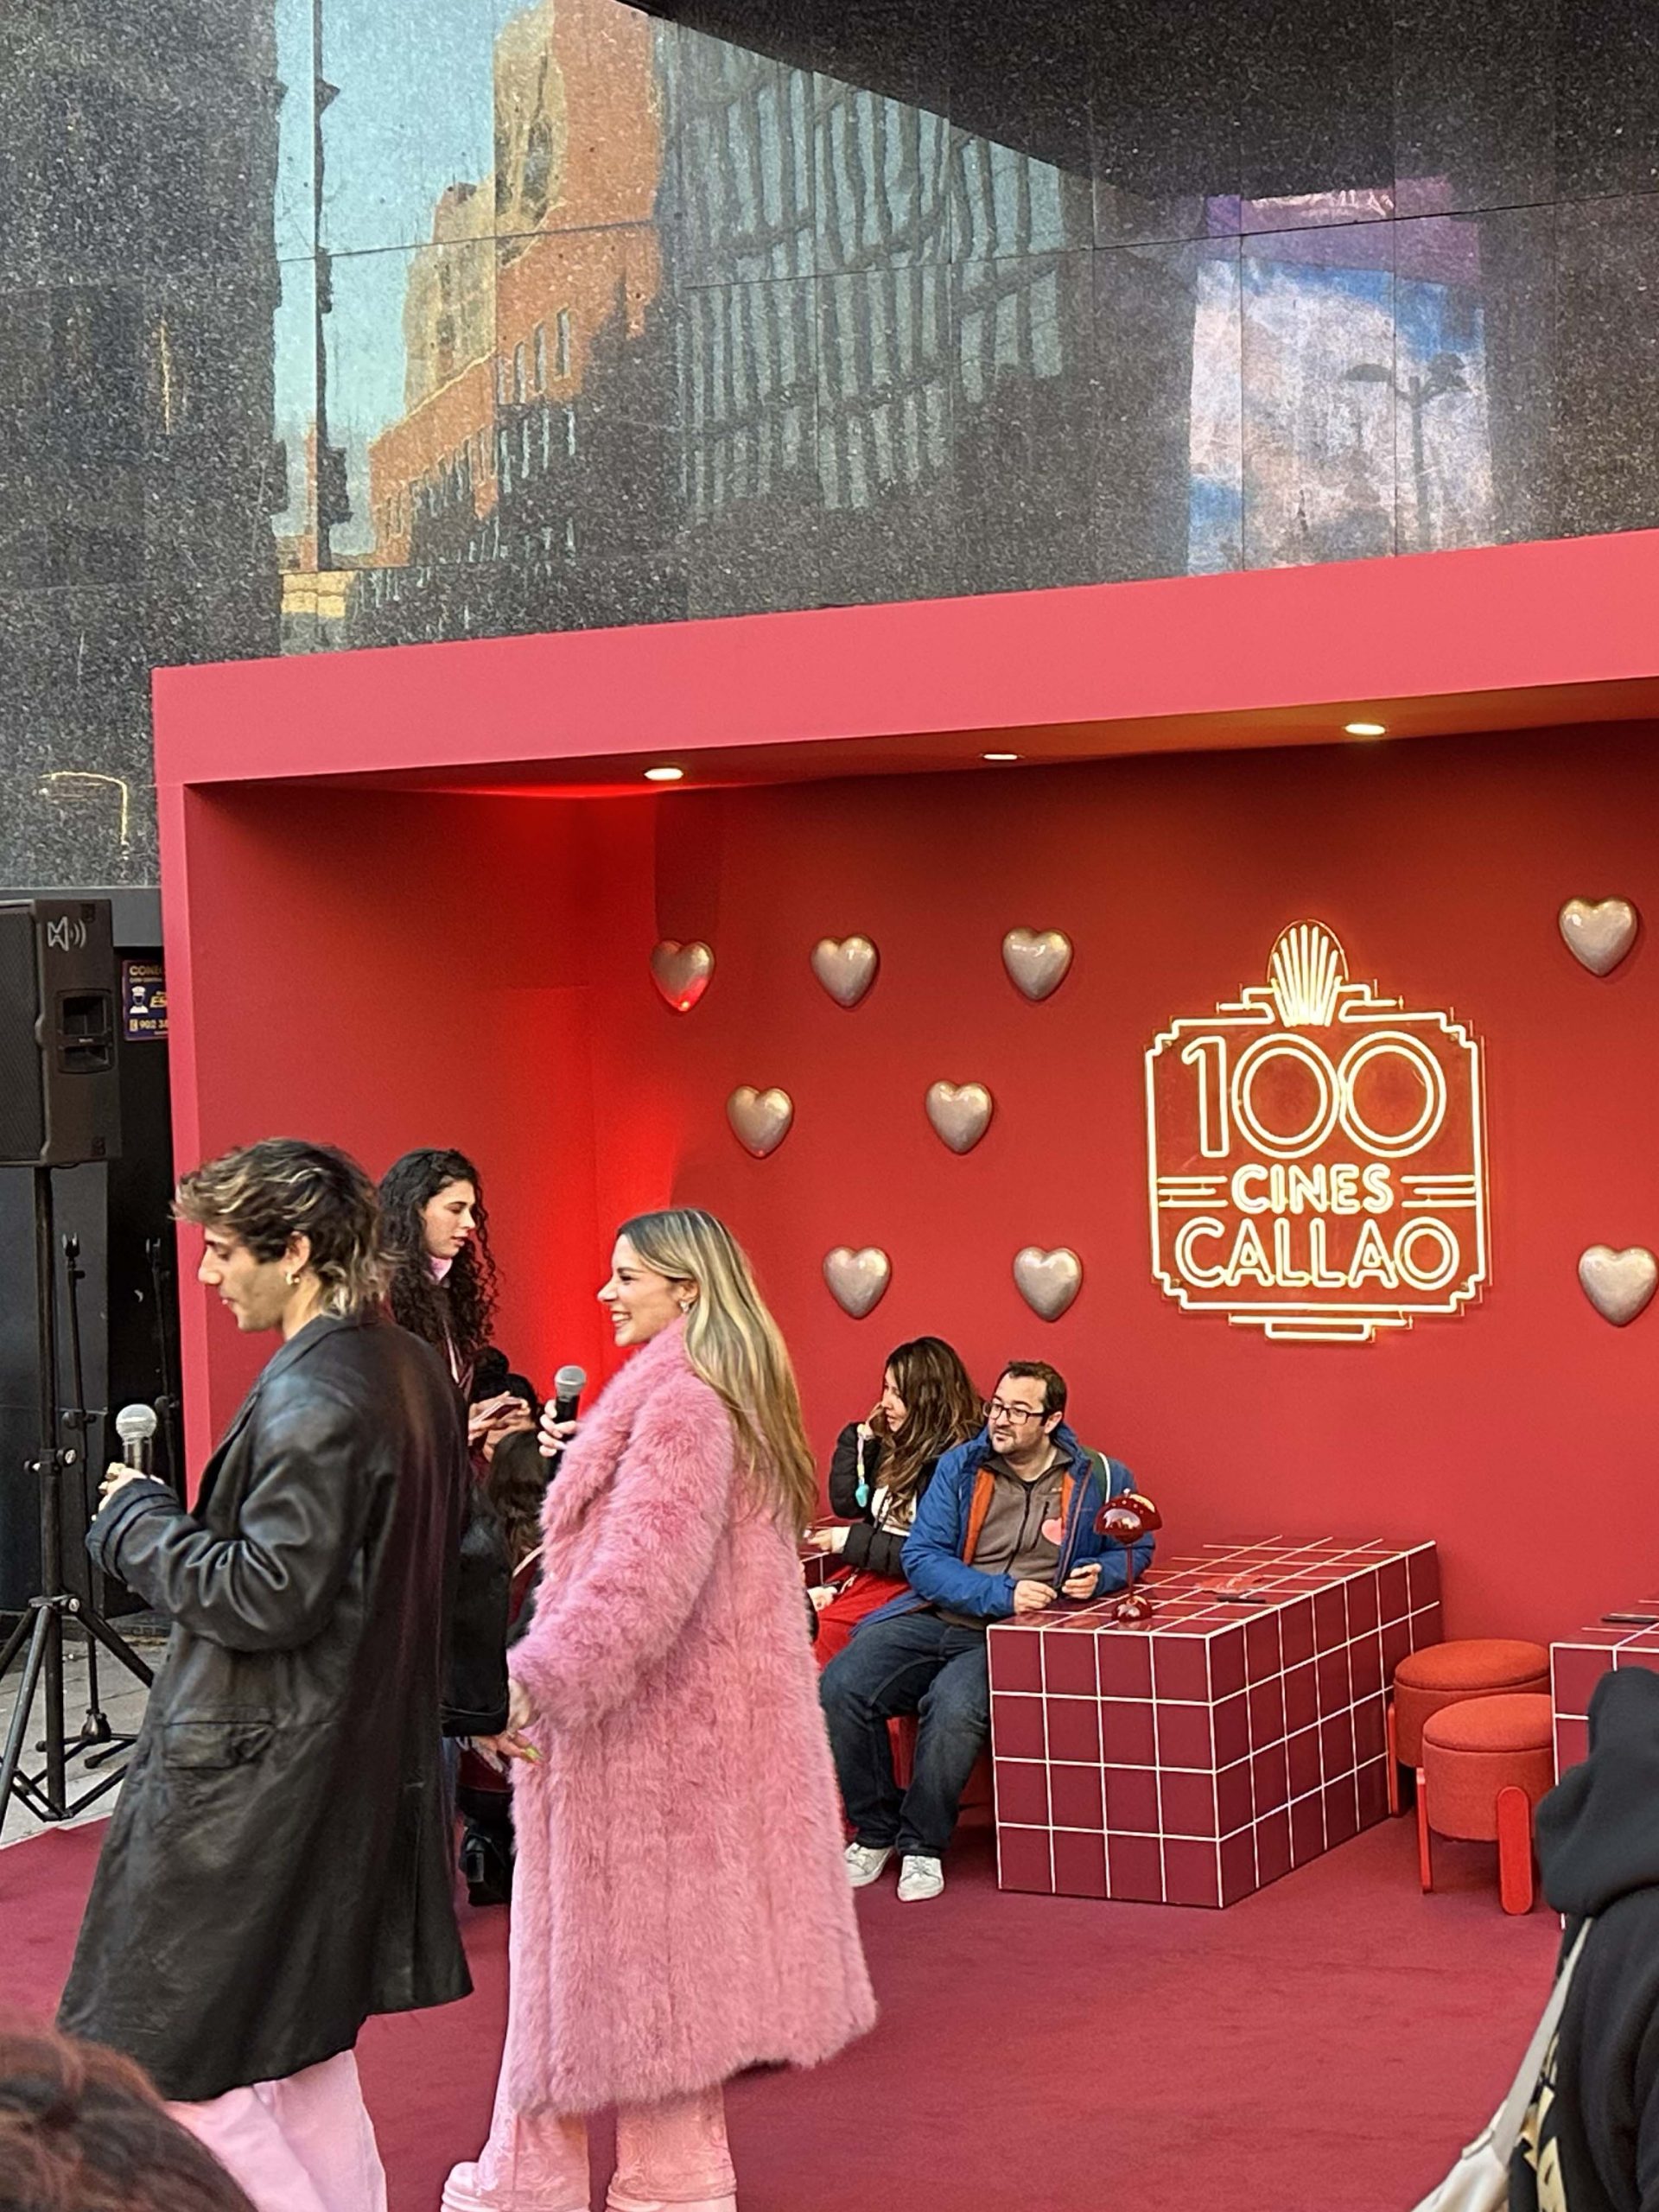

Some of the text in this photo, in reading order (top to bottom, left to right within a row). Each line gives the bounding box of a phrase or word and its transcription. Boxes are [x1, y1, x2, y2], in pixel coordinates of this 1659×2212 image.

[1181, 1031, 1446, 1159] 100
[1231, 1163, 1394, 1214] CINES
[1175, 1216, 1460, 1291] CALLAO
